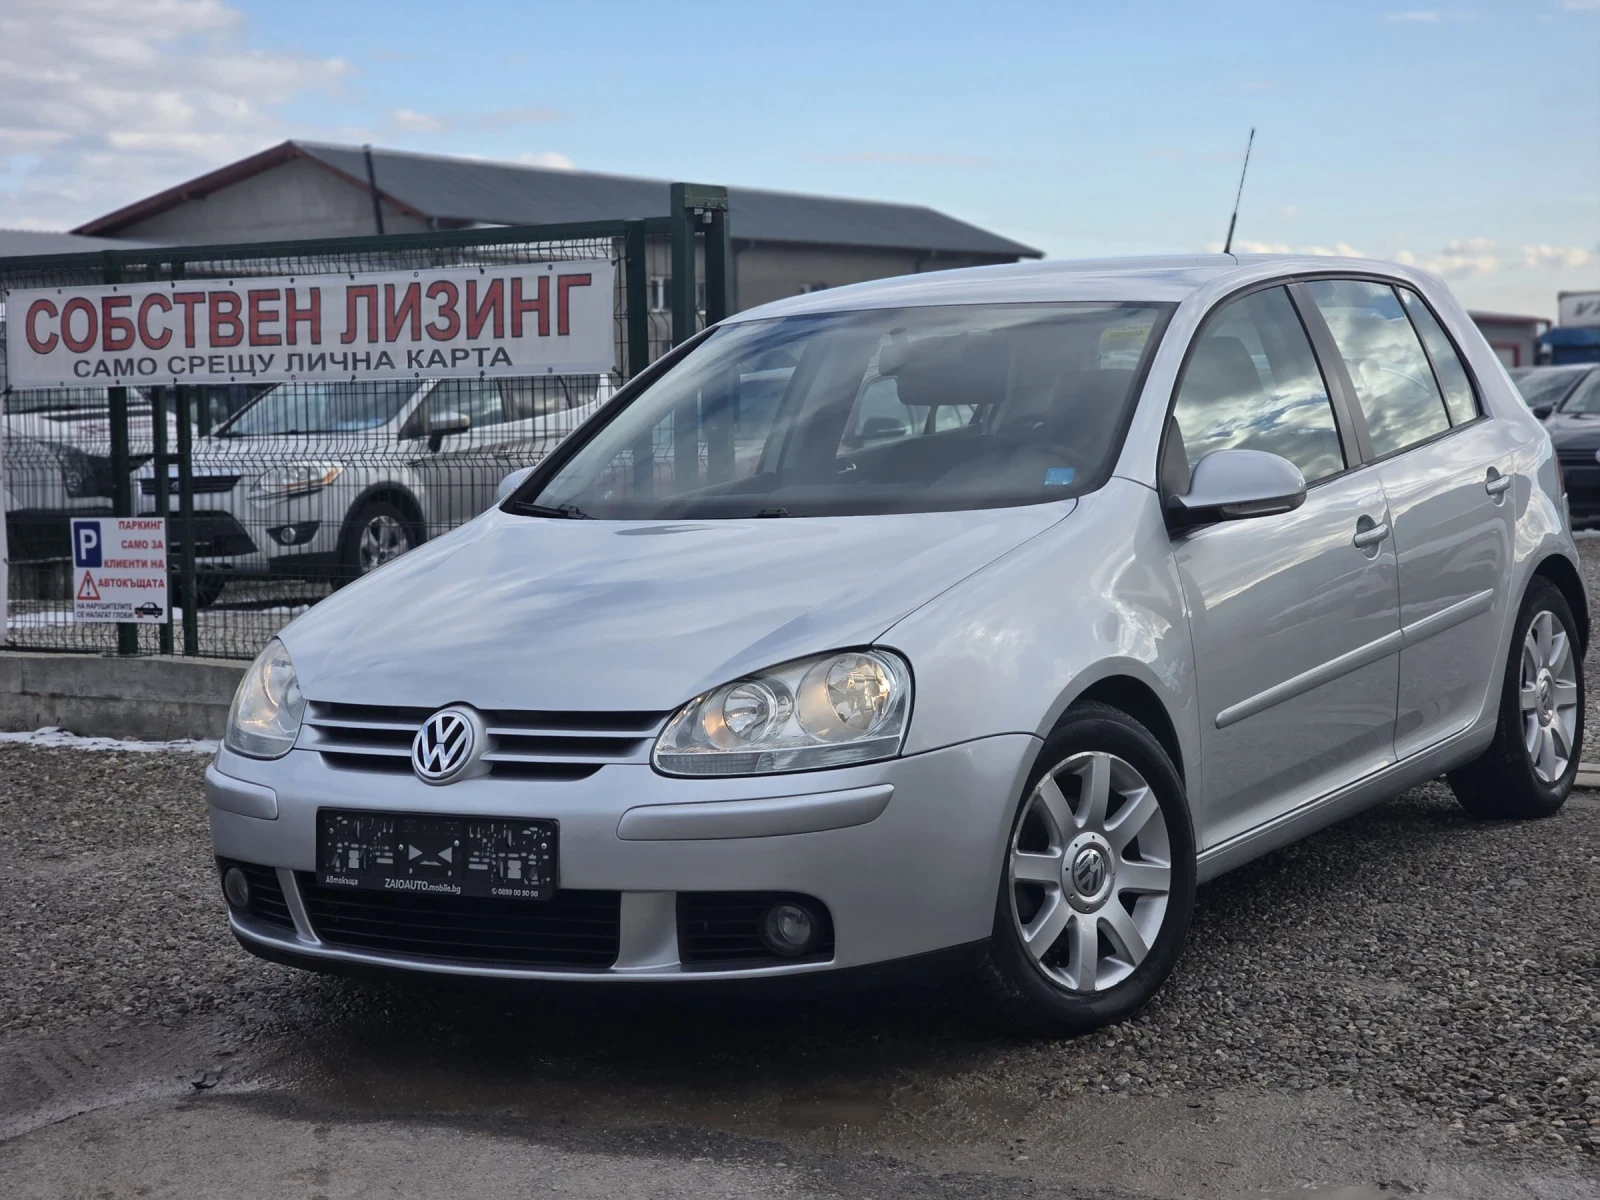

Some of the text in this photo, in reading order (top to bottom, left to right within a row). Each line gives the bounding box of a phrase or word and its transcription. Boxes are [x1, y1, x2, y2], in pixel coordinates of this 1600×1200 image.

[26, 273, 592, 355] СОБСТВЕН ЛИЗИНГ
[73, 346, 513, 378] САМО СРЕЩУ ЛИЧНА КАРТА
[118, 520, 163, 530] ПАРКИНГ
[121, 539, 164, 549] САМО ЗА
[103, 560, 165, 569] КЛИЕНТИ НА
[97, 578, 166, 589] АВТОКЪЩАТА
[86, 602, 133, 611] НАРУШИТЕЛИТЕ
[384, 877, 462, 895] ZAIOAUTO.mobile.bg
[513, 888, 522, 896] 00
